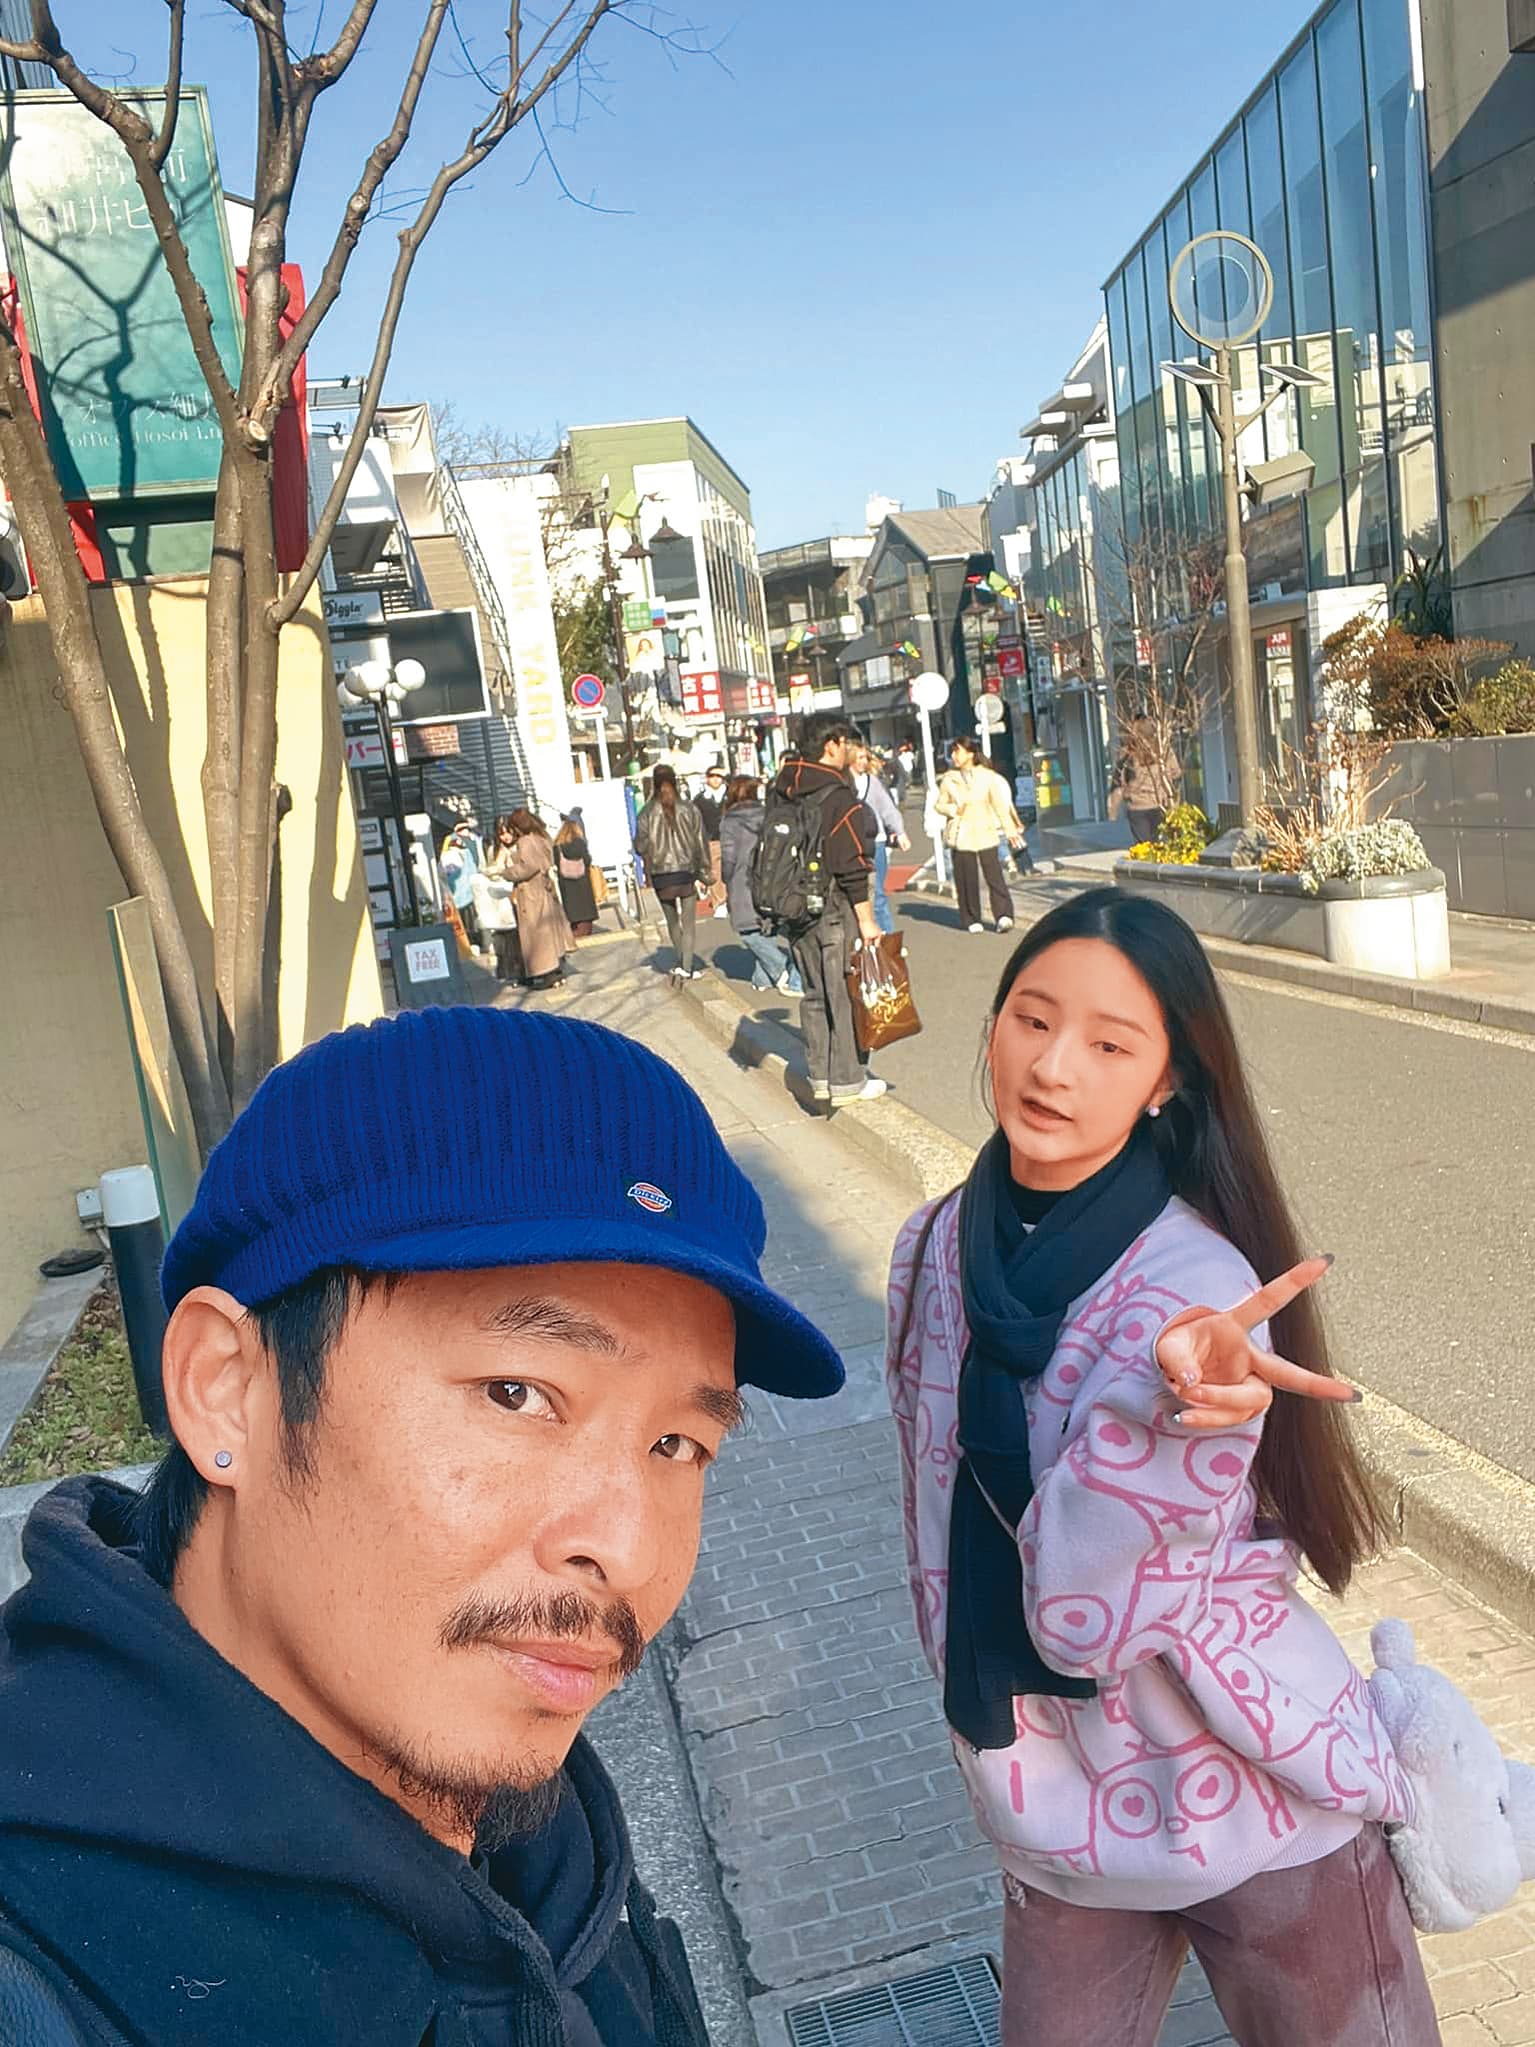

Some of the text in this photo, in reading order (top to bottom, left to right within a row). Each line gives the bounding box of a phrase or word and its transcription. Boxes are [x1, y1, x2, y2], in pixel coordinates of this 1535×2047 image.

[519, 641, 558, 746] YARD
[415, 948, 437, 961] TAX
[415, 958, 441, 972] FREE
